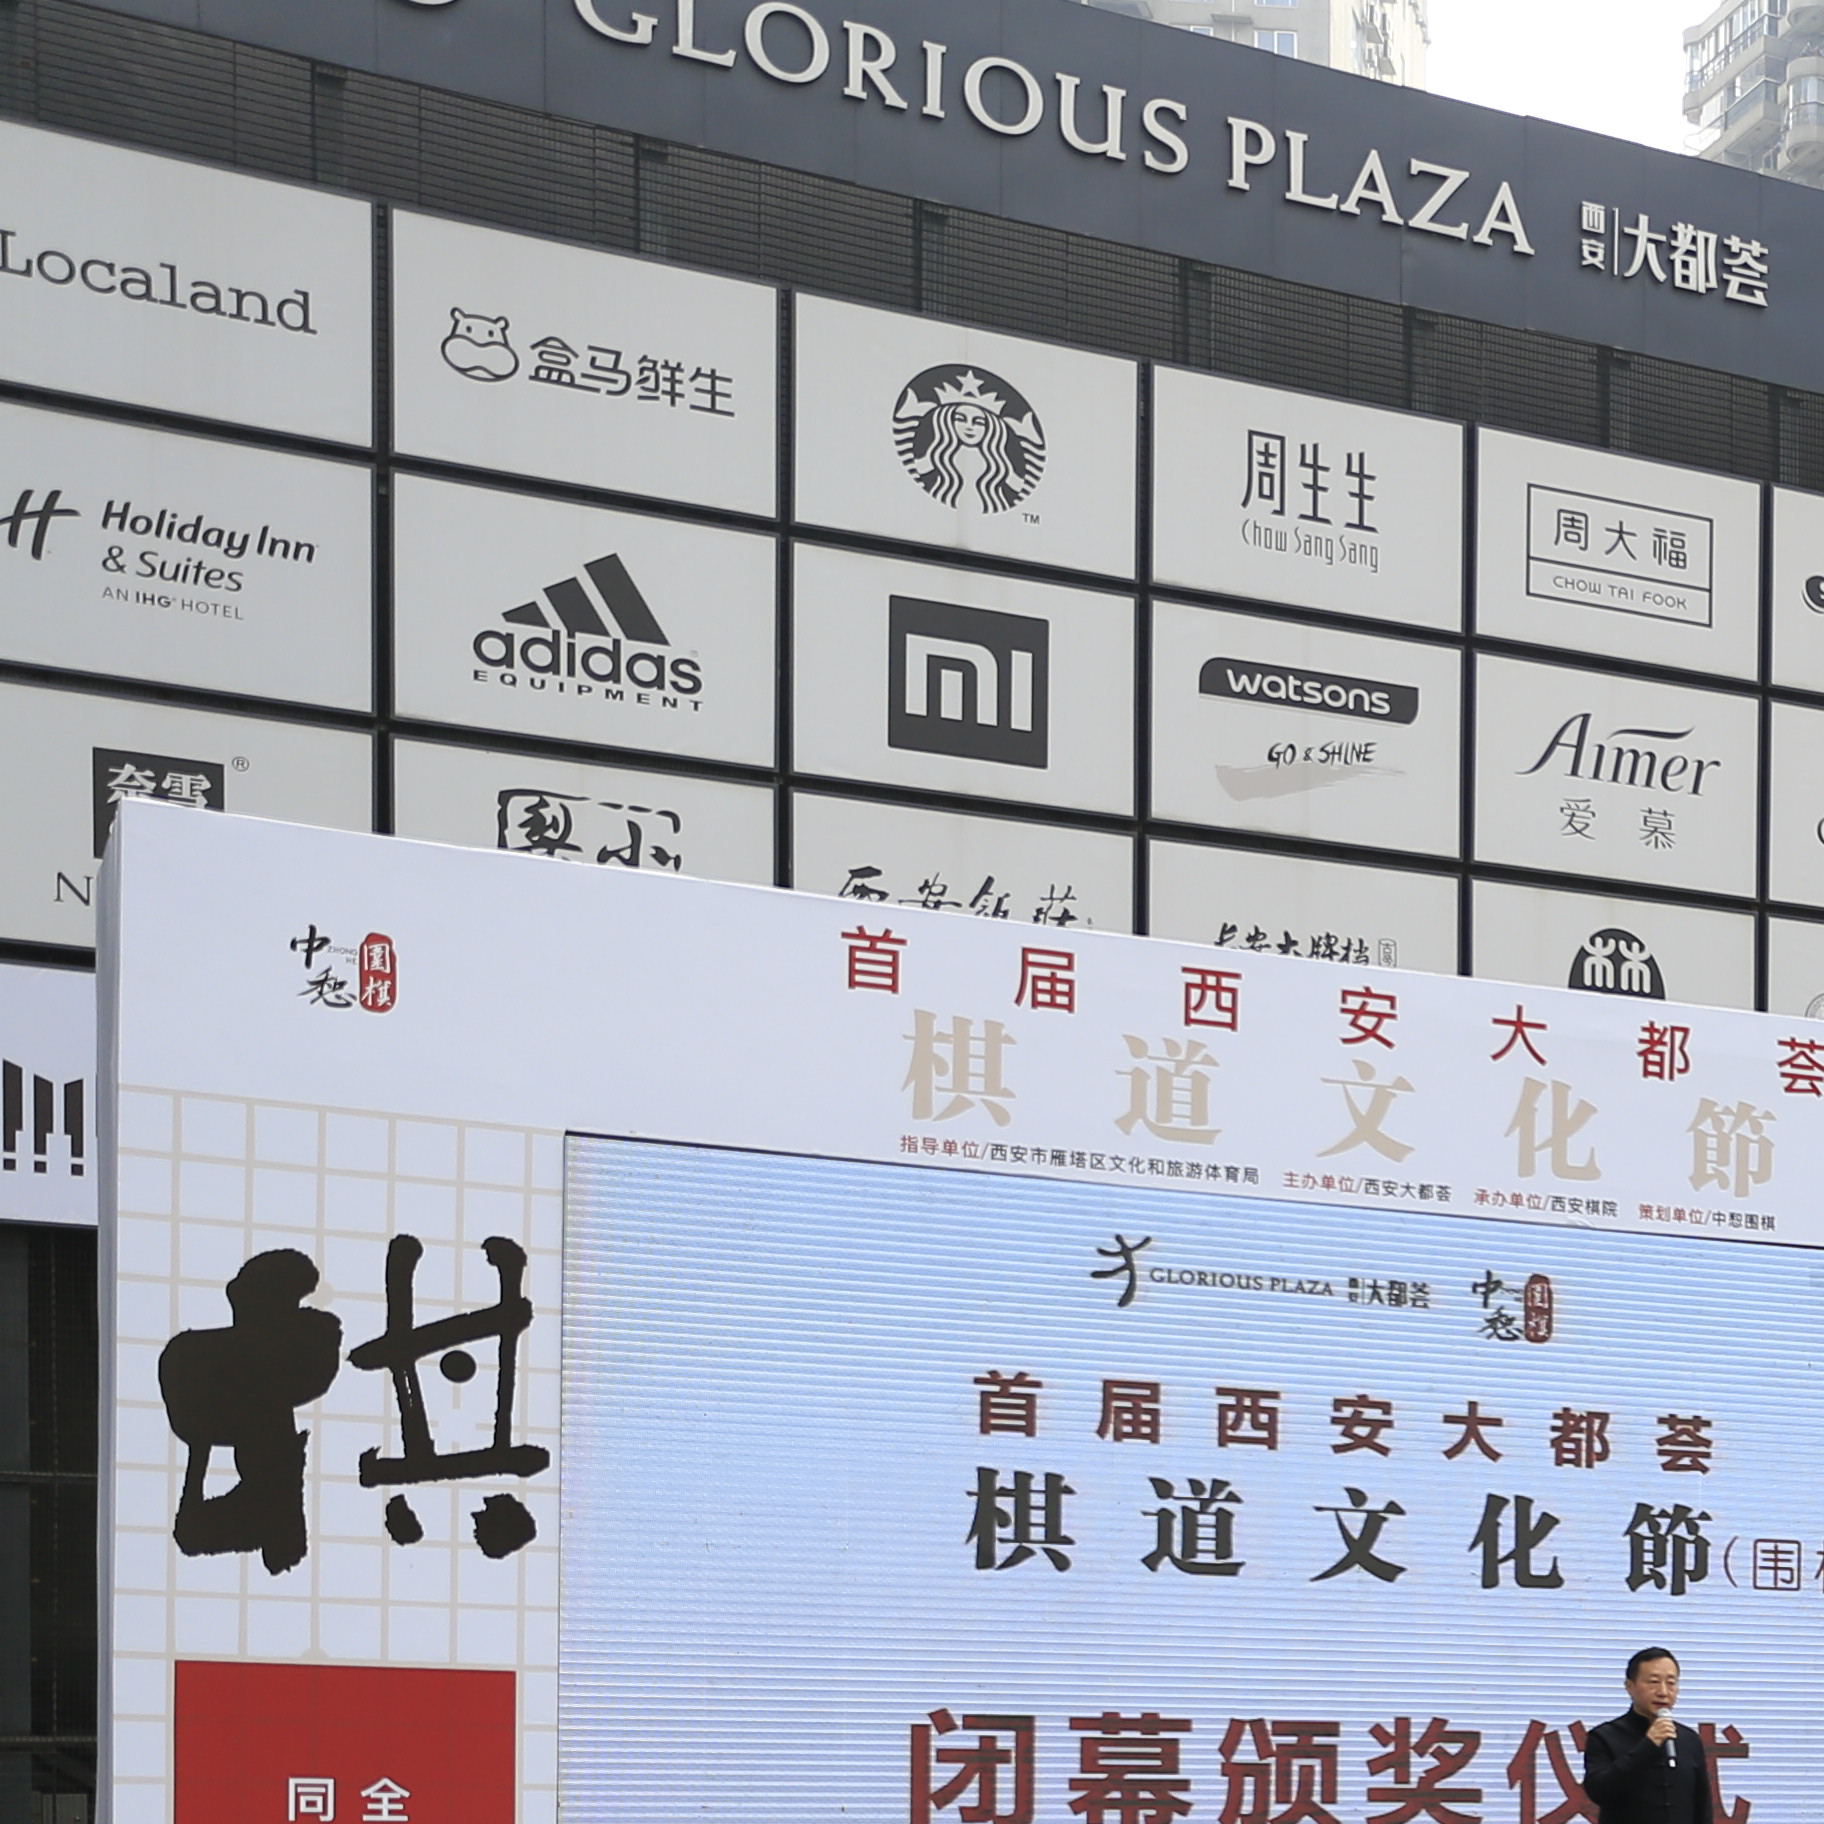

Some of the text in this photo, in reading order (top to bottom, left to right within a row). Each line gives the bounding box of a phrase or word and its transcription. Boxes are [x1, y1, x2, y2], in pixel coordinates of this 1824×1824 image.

[572, 0, 1535, 256] GLORIOUS PLAZA
[0, 228, 318, 335] Localand
[1621, 213, 1769, 308] 大都荟
[528, 336, 736, 418] 盒马鲜生
[1241, 428, 1380, 534] 周生生
[101, 499, 316, 564] Holiday Inn
[1241, 517, 1379, 574] Chow Sang Sang
[1552, 507, 1689, 570] 周大福
[101, 544, 244, 593] & Suites
[1552, 575, 1689, 611] CHOW TAI FOOK
[101, 586, 244, 621] AN IHG HOTEL
[473, 626, 703, 696] adidas
[473, 669, 703, 712] EQUIPMENT
[1226, 669, 1392, 716] watsons
[1267, 741, 1297, 767] GO
[1317, 741, 1378, 767] SHINE
[1516, 712, 1721, 797] Aimer
[1559, 797, 1677, 851] 爱慕
[901, 1009, 1776, 1198] 棋道文化節
[899, 1134, 1260, 1186] 指导单位/西安市雁塔区文化和旅游体育局
[1282, 1170, 1452, 1203] 主办单位/西安大都荟
[1473, 1187, 1619, 1218] 承办单位/西安棋院
[1149, 1267, 1333, 1297] GLORIOUS PLAZA
[159, 1231, 551, 1575] 棋
[974, 1370, 1714, 1476] 首届西安大都荟
